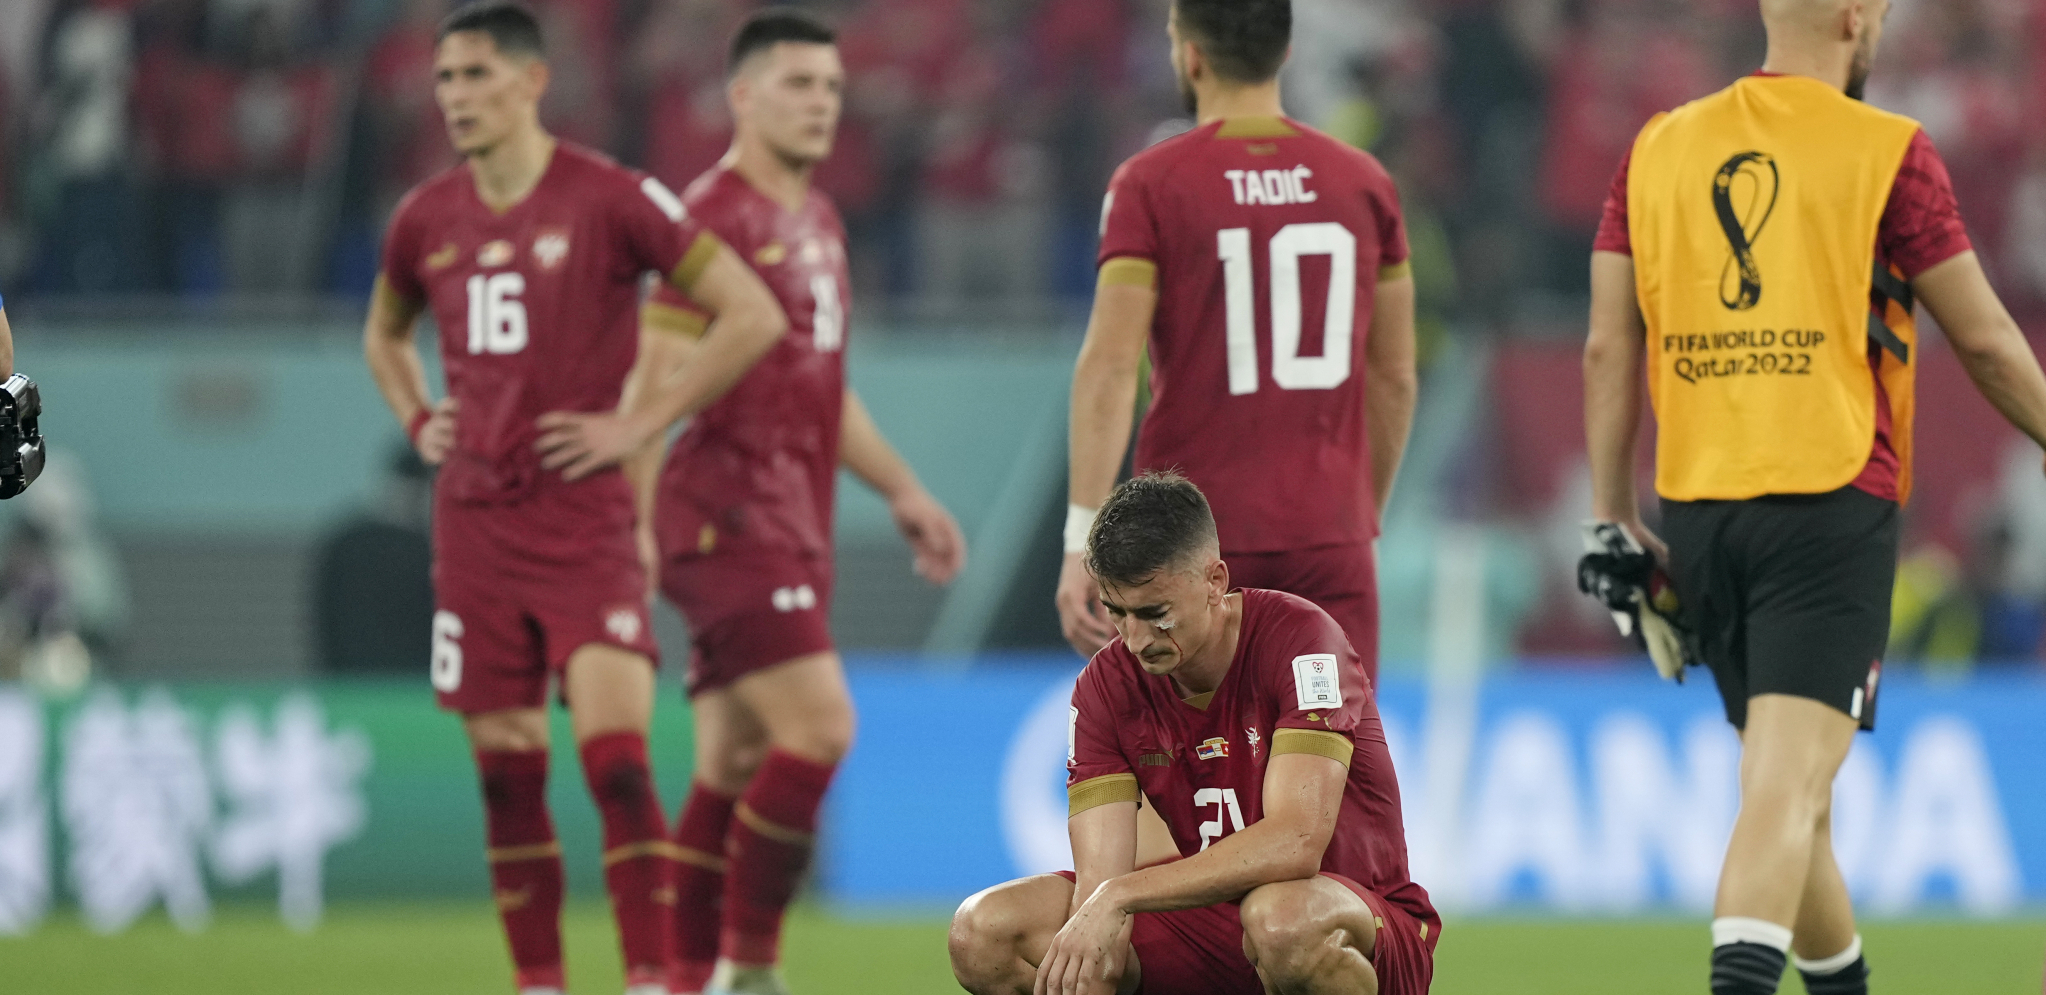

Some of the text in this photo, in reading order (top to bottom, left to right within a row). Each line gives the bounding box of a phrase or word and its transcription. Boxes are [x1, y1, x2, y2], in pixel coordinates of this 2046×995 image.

[1224, 164, 1318, 205] TADIĆ
[466, 271, 530, 355] 16
[1217, 222, 1356, 395] 10
[1664, 329, 1825, 352] FIFA WORLD CUP
[1194, 788, 1246, 852] 21
